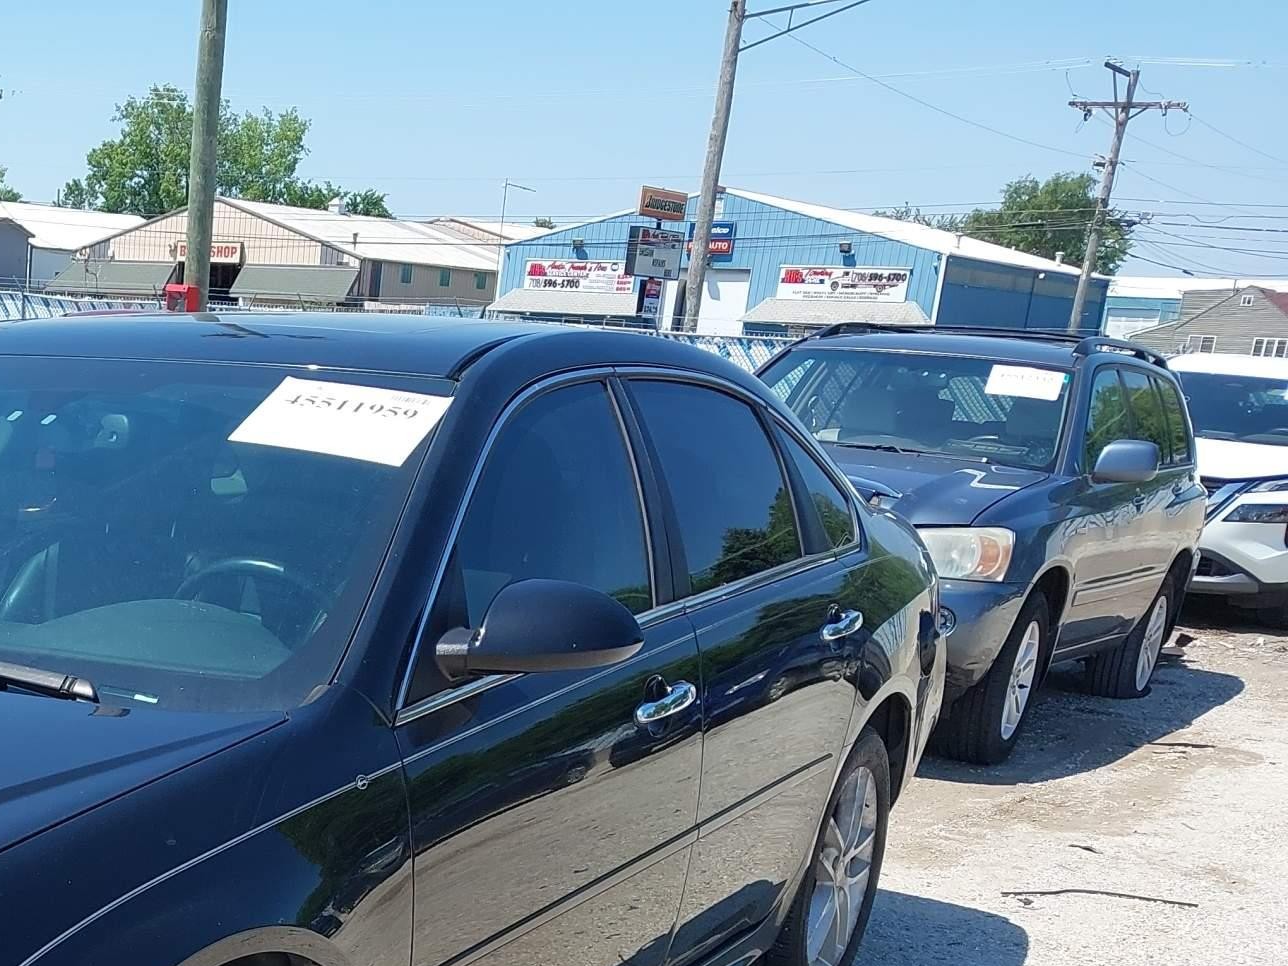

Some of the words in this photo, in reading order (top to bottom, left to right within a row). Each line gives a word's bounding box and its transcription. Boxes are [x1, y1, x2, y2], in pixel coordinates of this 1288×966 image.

[645, 194, 686, 214] BRIDGESTONE
[209, 245, 238, 258] SHOP
[285, 394, 420, 420] 45511959
